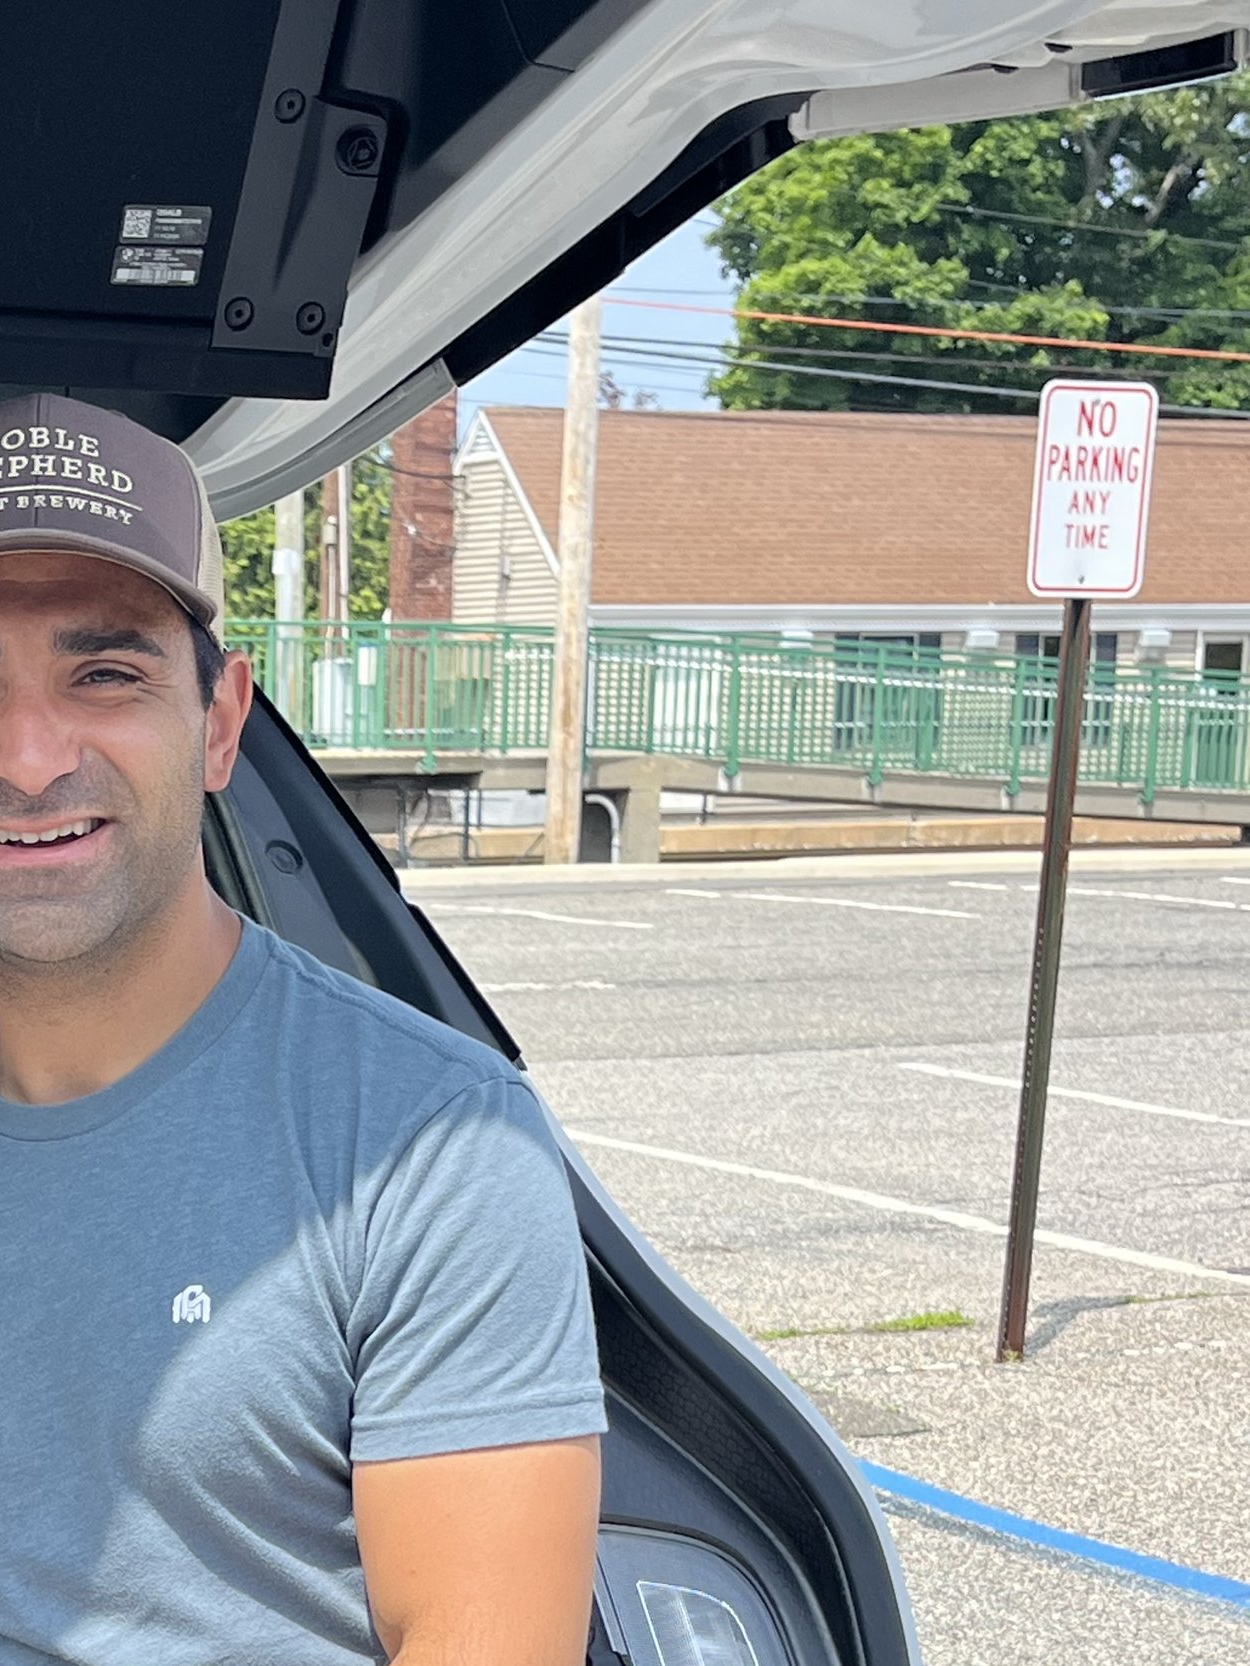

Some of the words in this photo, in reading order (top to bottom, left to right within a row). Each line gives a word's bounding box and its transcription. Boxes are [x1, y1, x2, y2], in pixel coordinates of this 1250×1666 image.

[1076, 400, 1117, 438] NO
[1047, 444, 1140, 484] PARKING
[16, 495, 134, 526] BREWERY
[1068, 490, 1111, 515] ANY
[1064, 524, 1111, 550] TIME
